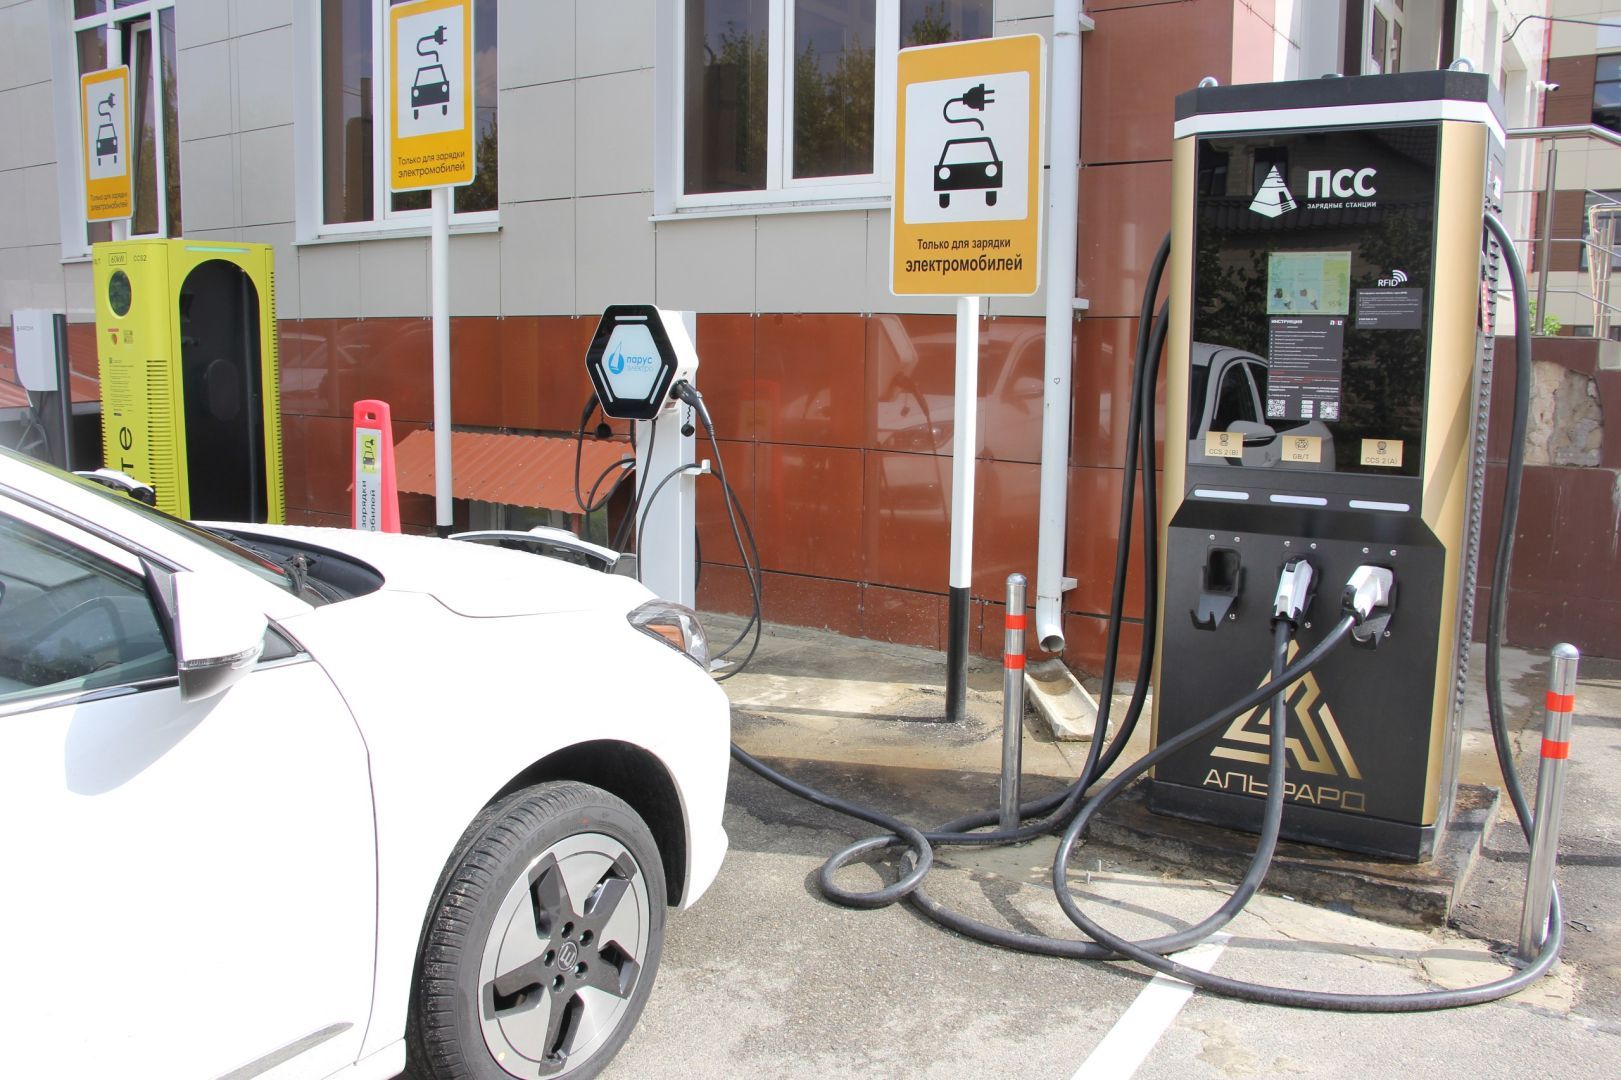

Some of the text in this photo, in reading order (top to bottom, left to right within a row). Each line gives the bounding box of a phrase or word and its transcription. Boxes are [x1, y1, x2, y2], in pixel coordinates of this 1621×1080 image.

[398, 151, 465, 165] Только для зарядки
[398, 161, 465, 178] электромобилей
[1307, 167, 1377, 199] ПСС
[1345, 201, 1377, 210] СТАНЦИИ
[917, 238, 1011, 250] Только для зарядки
[905, 253, 1023, 275] электромобилей
[1377, 279, 1399, 287] RFID
[626, 356, 653, 366] парус
[1365, 456, 1380, 464] CCS
